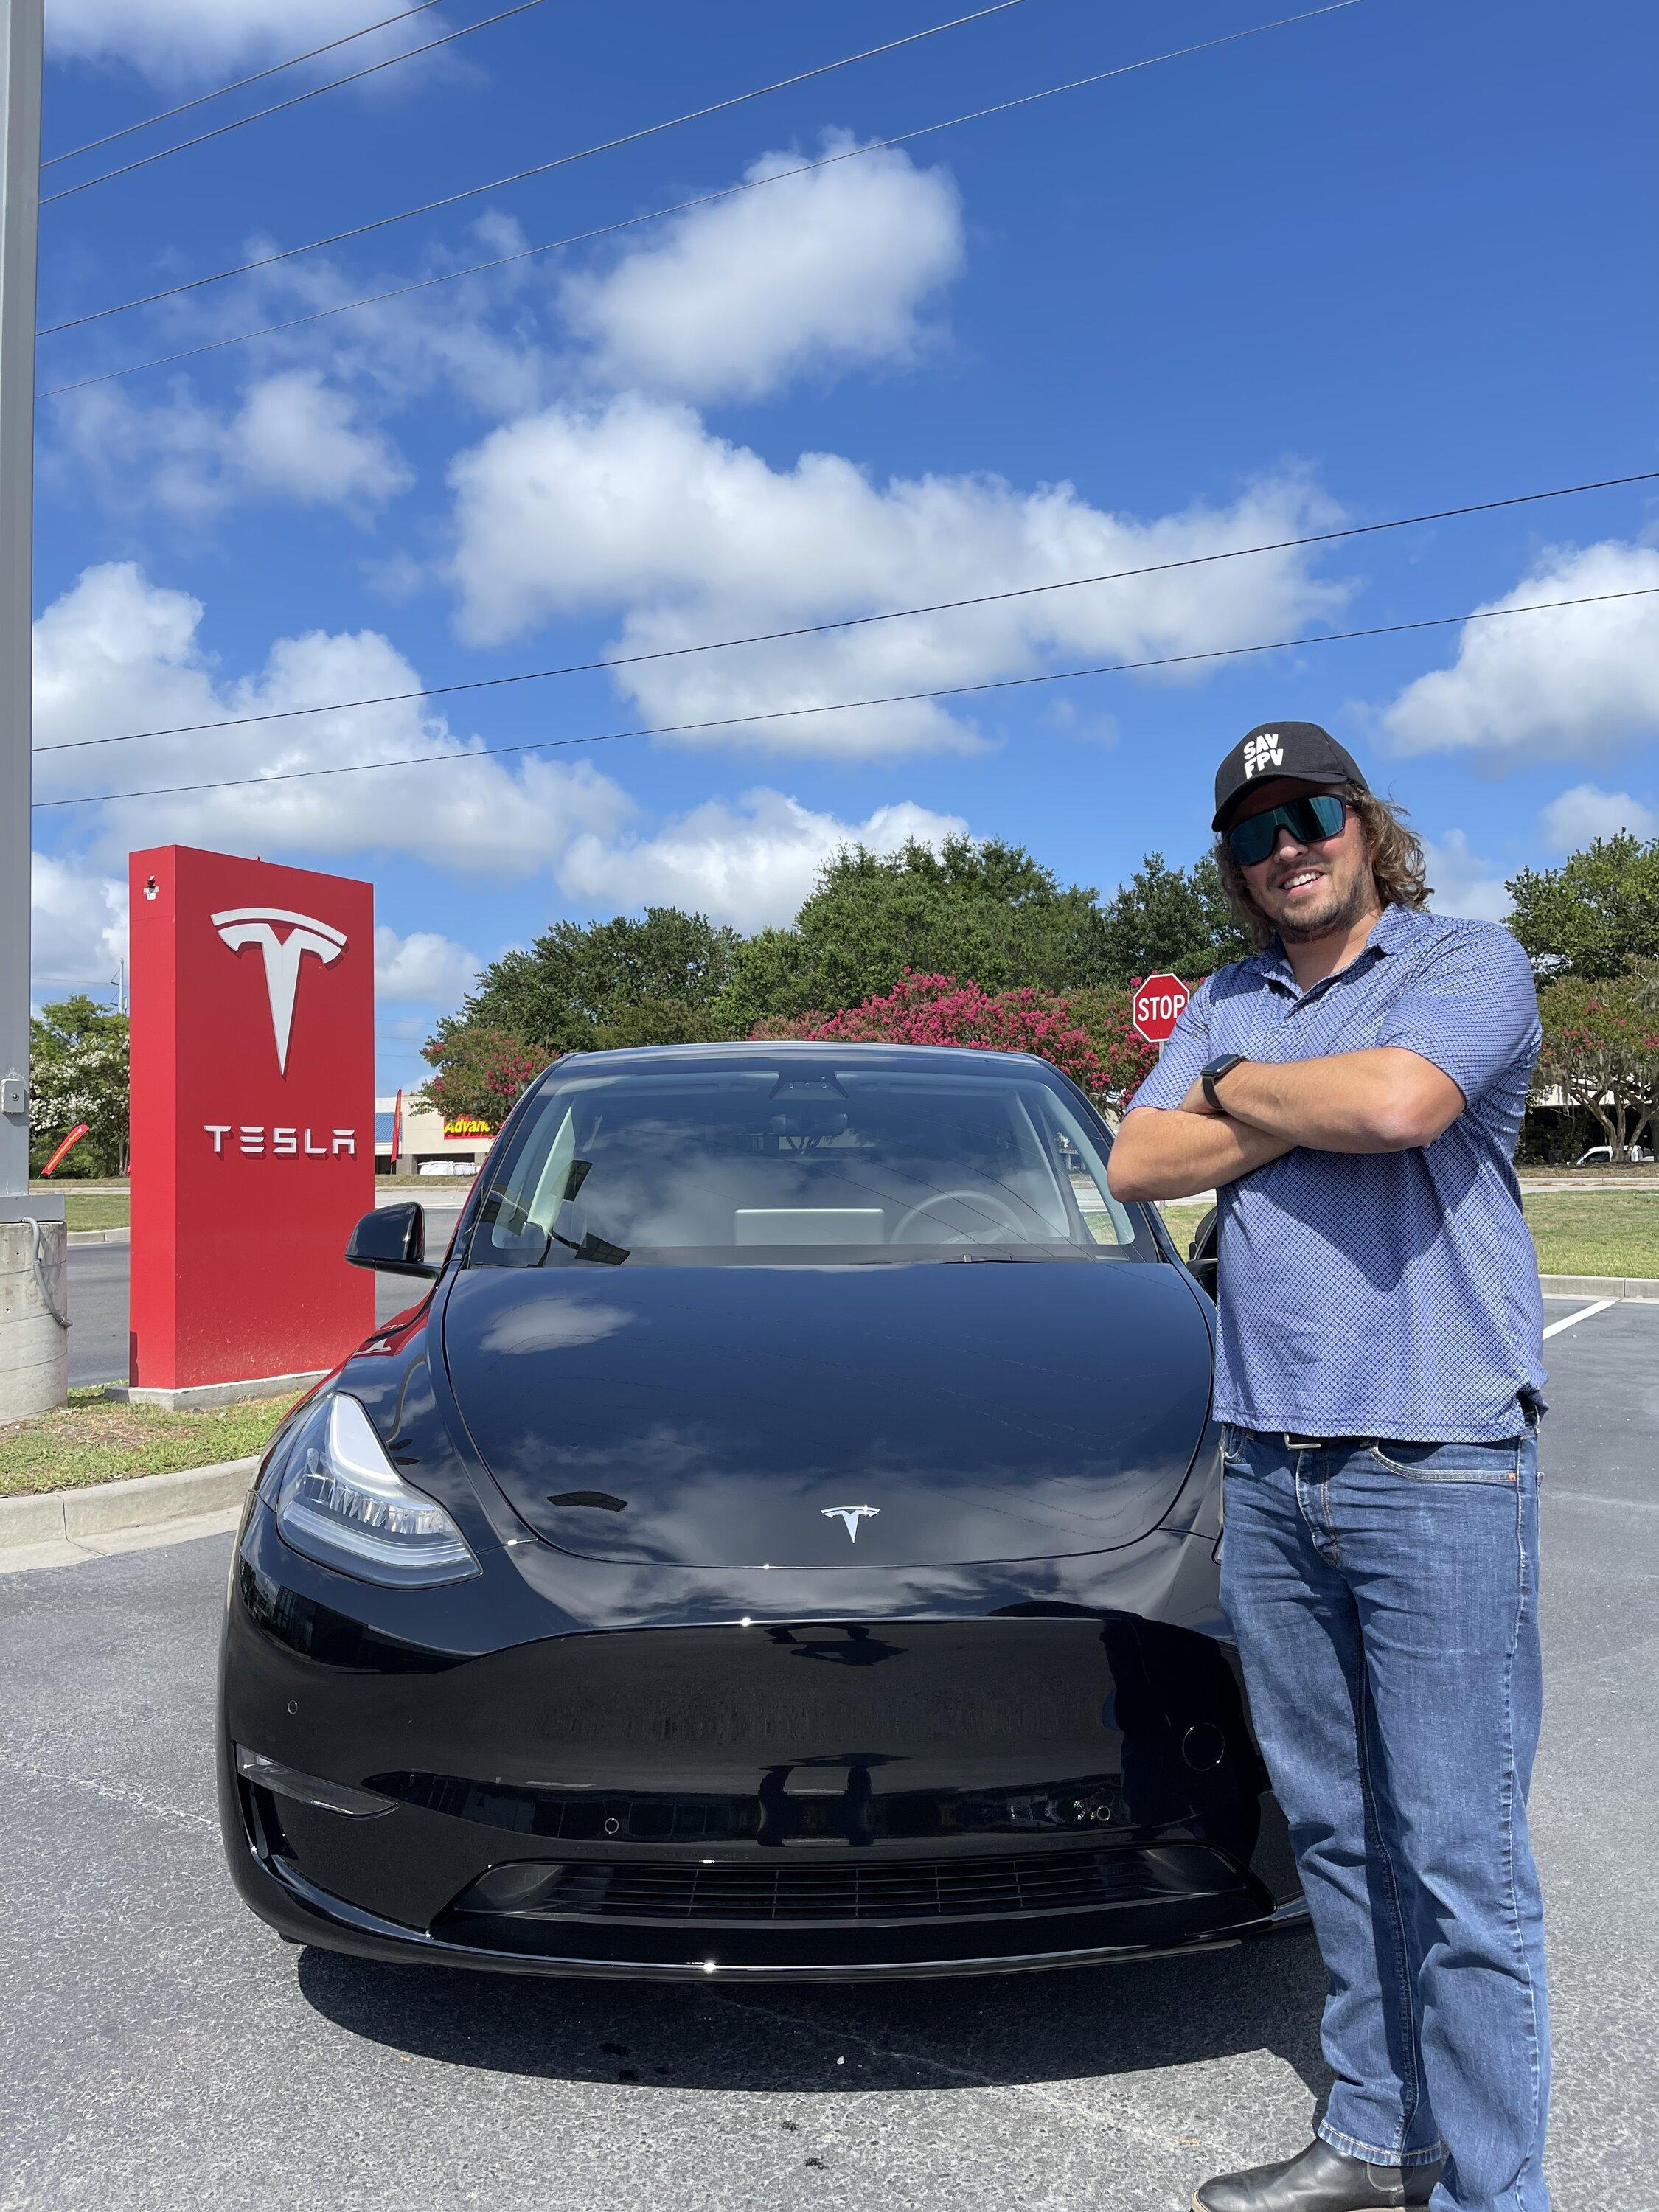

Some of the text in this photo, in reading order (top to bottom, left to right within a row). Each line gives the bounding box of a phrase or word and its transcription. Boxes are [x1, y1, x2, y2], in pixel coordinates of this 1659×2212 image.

[1243, 733, 1279, 759] SAV
[1244, 748, 1284, 779] FPV
[1138, 994, 1185, 1022] STOP
[203, 1125, 355, 1154] TESLA
